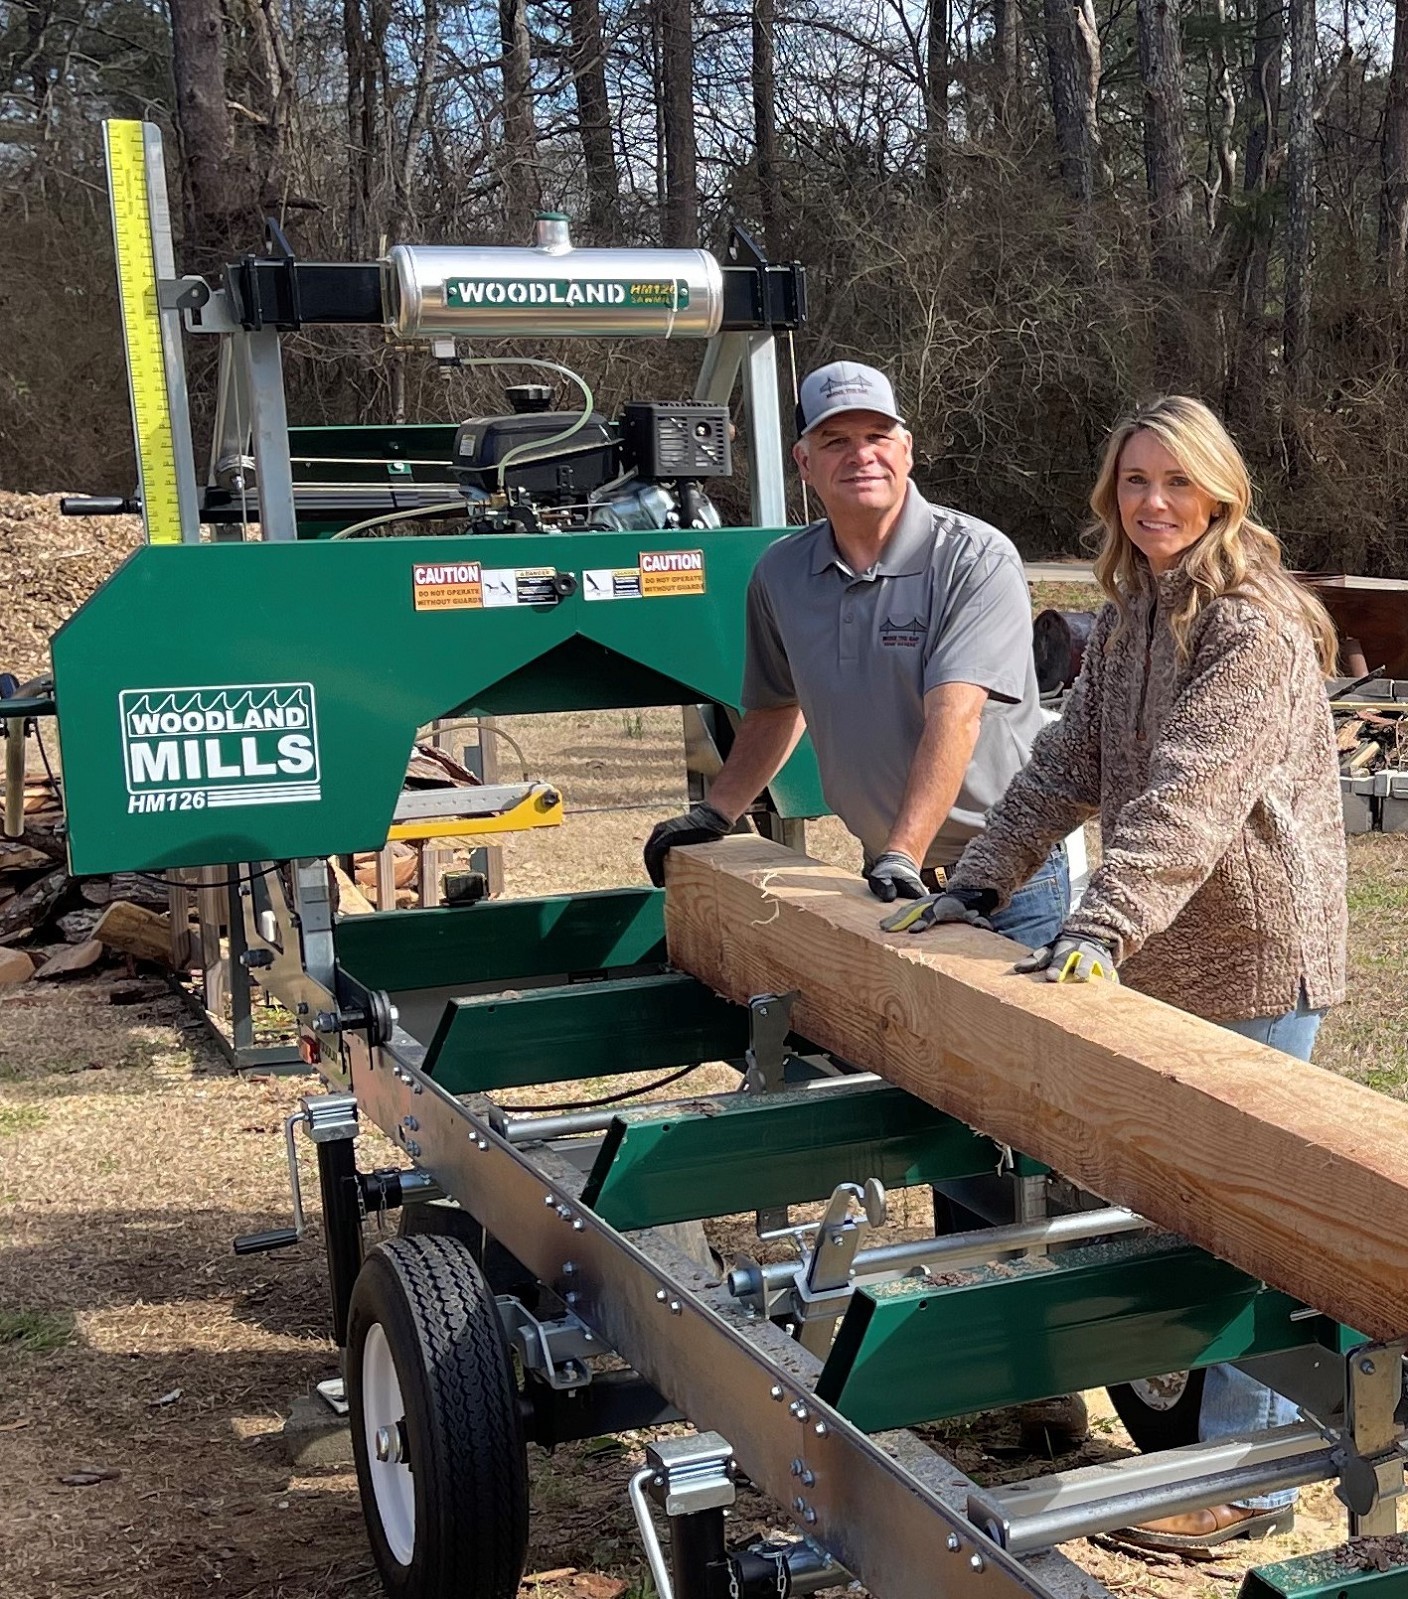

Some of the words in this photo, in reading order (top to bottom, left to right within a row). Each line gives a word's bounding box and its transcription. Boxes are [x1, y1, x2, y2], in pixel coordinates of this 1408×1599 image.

[458, 282, 625, 303] WOODLAND
[642, 554, 702, 572] CAUTION
[415, 566, 479, 585] CAUTION
[417, 598, 451, 606] WITHOUT
[430, 589, 445, 597] NOT
[447, 588, 480, 596] OPERATE
[131, 706, 305, 735] WOODLAND
[130, 734, 314, 783] MILLS
[127, 791, 206, 814] HM126
